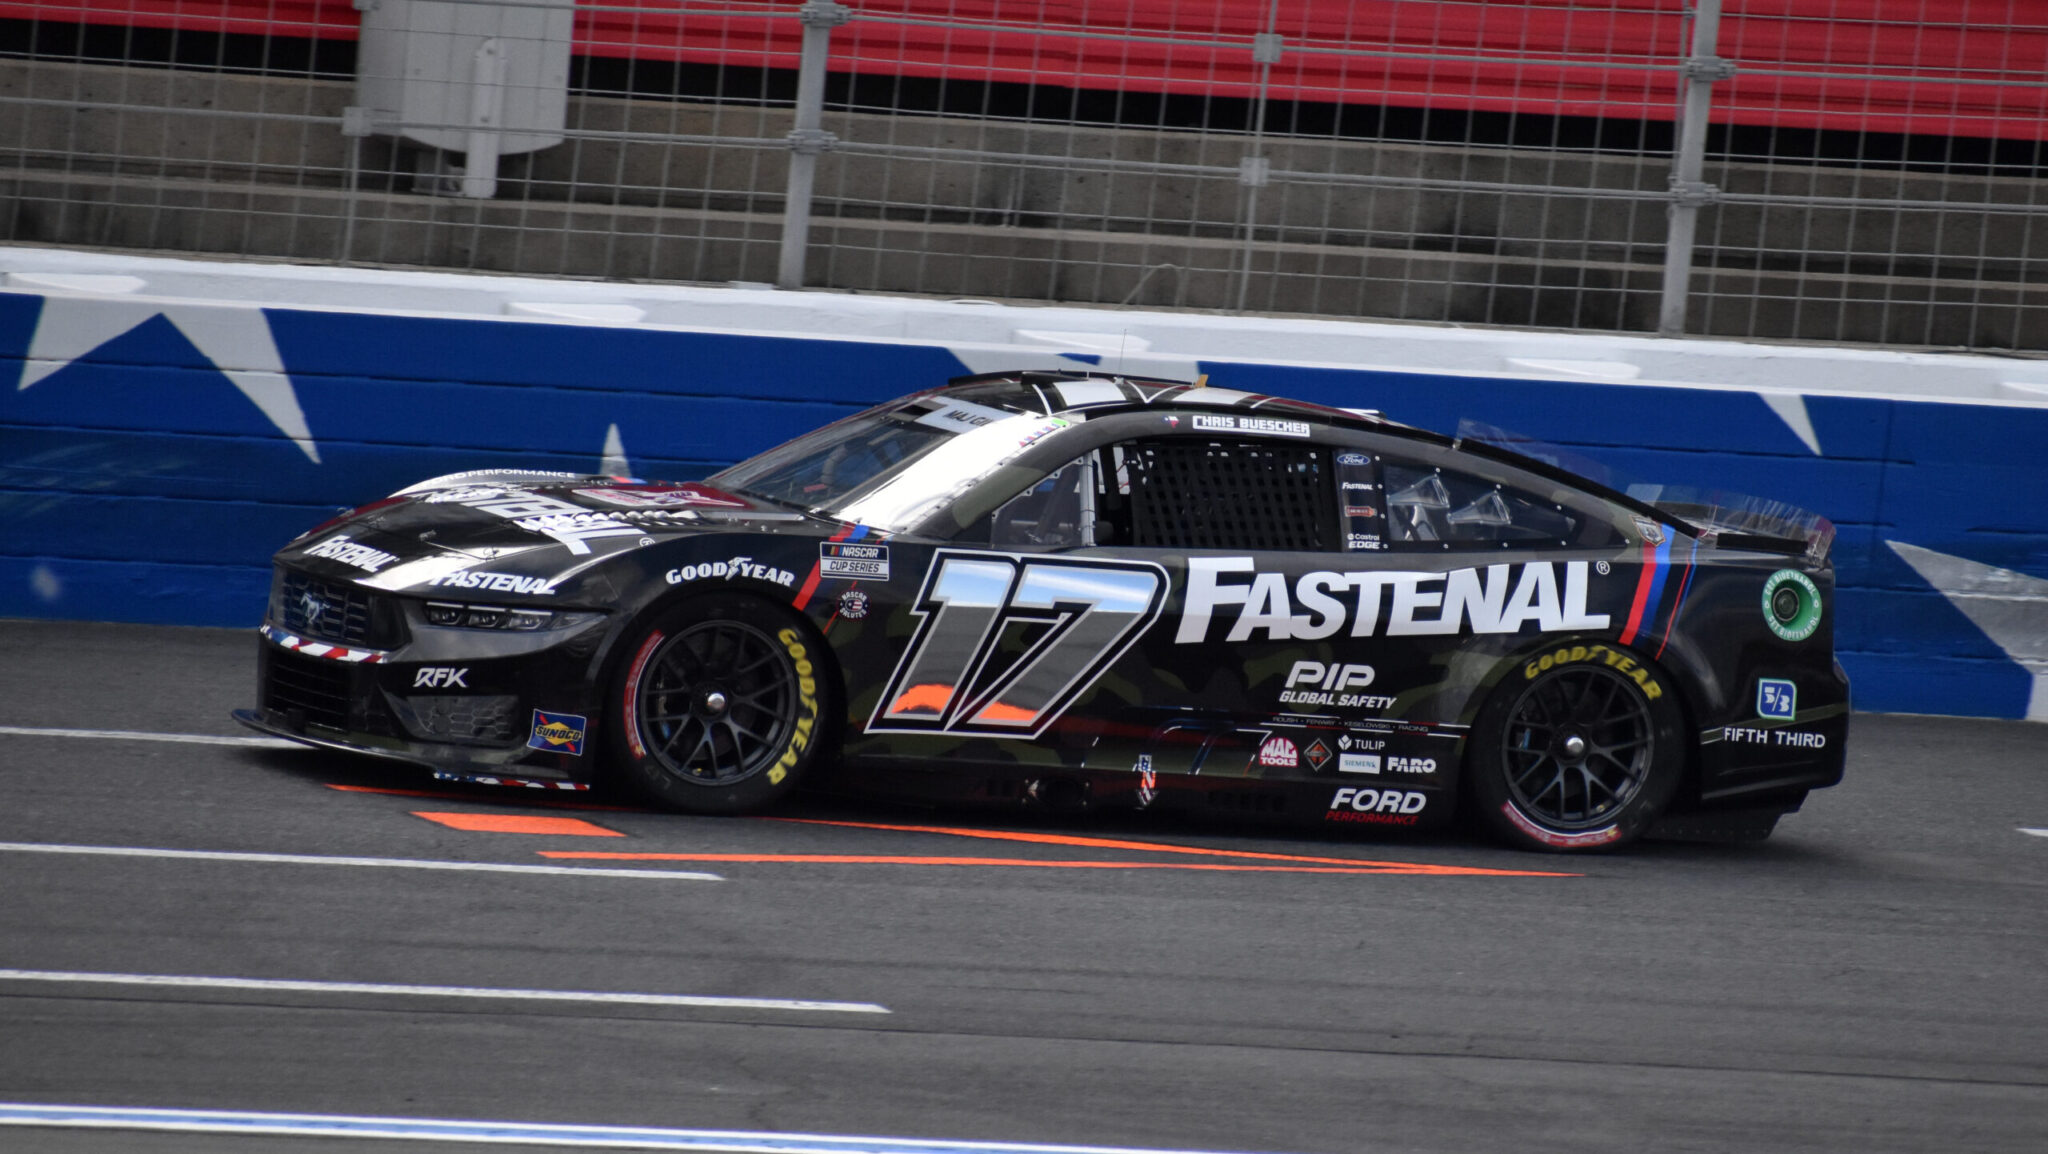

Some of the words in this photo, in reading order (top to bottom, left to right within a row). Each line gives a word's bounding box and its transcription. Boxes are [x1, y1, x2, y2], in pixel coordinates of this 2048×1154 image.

[1192, 415, 1235, 429] CHRIS
[1240, 419, 1311, 436] BUESCHER
[1341, 454, 1366, 465] Ford
[467, 468, 575, 478] PERFORMANCE
[1342, 481, 1374, 490] FASTENAL
[1348, 541, 1381, 549] EDGE
[1354, 533, 1380, 541] Castrol
[303, 534, 398, 573] FASTENAL
[842, 546, 879, 558] NASCAR
[829, 560, 848, 571] CUP
[848, 562, 880, 573] SERIES
[428, 570, 556, 595] FASTENAL
[841, 591, 867, 602] NASCAR
[866, 550, 1169, 737] 17
[413, 667, 469, 688] RFK
[1285, 660, 1375, 691] PIP
[1279, 691, 1335, 706] GLOBAL
[1337, 694, 1397, 709] SAFETY
[1273, 716, 1299, 724] ROUSH
[1398, 725, 1428, 733] RACING
[535, 725, 582, 741] SUNOCO
[1724, 727, 1768, 744] FIFTH
[1775, 731, 1826, 748] THIRD
[1261, 738, 1297, 757] MAC
[1355, 739, 1385, 751] TULIP
[1260, 757, 1297, 767] TOOLS
[1387, 756, 1437, 774] FARO
[1330, 787, 1427, 814] FORD
[1325, 810, 1419, 825] PERFORMANCE
